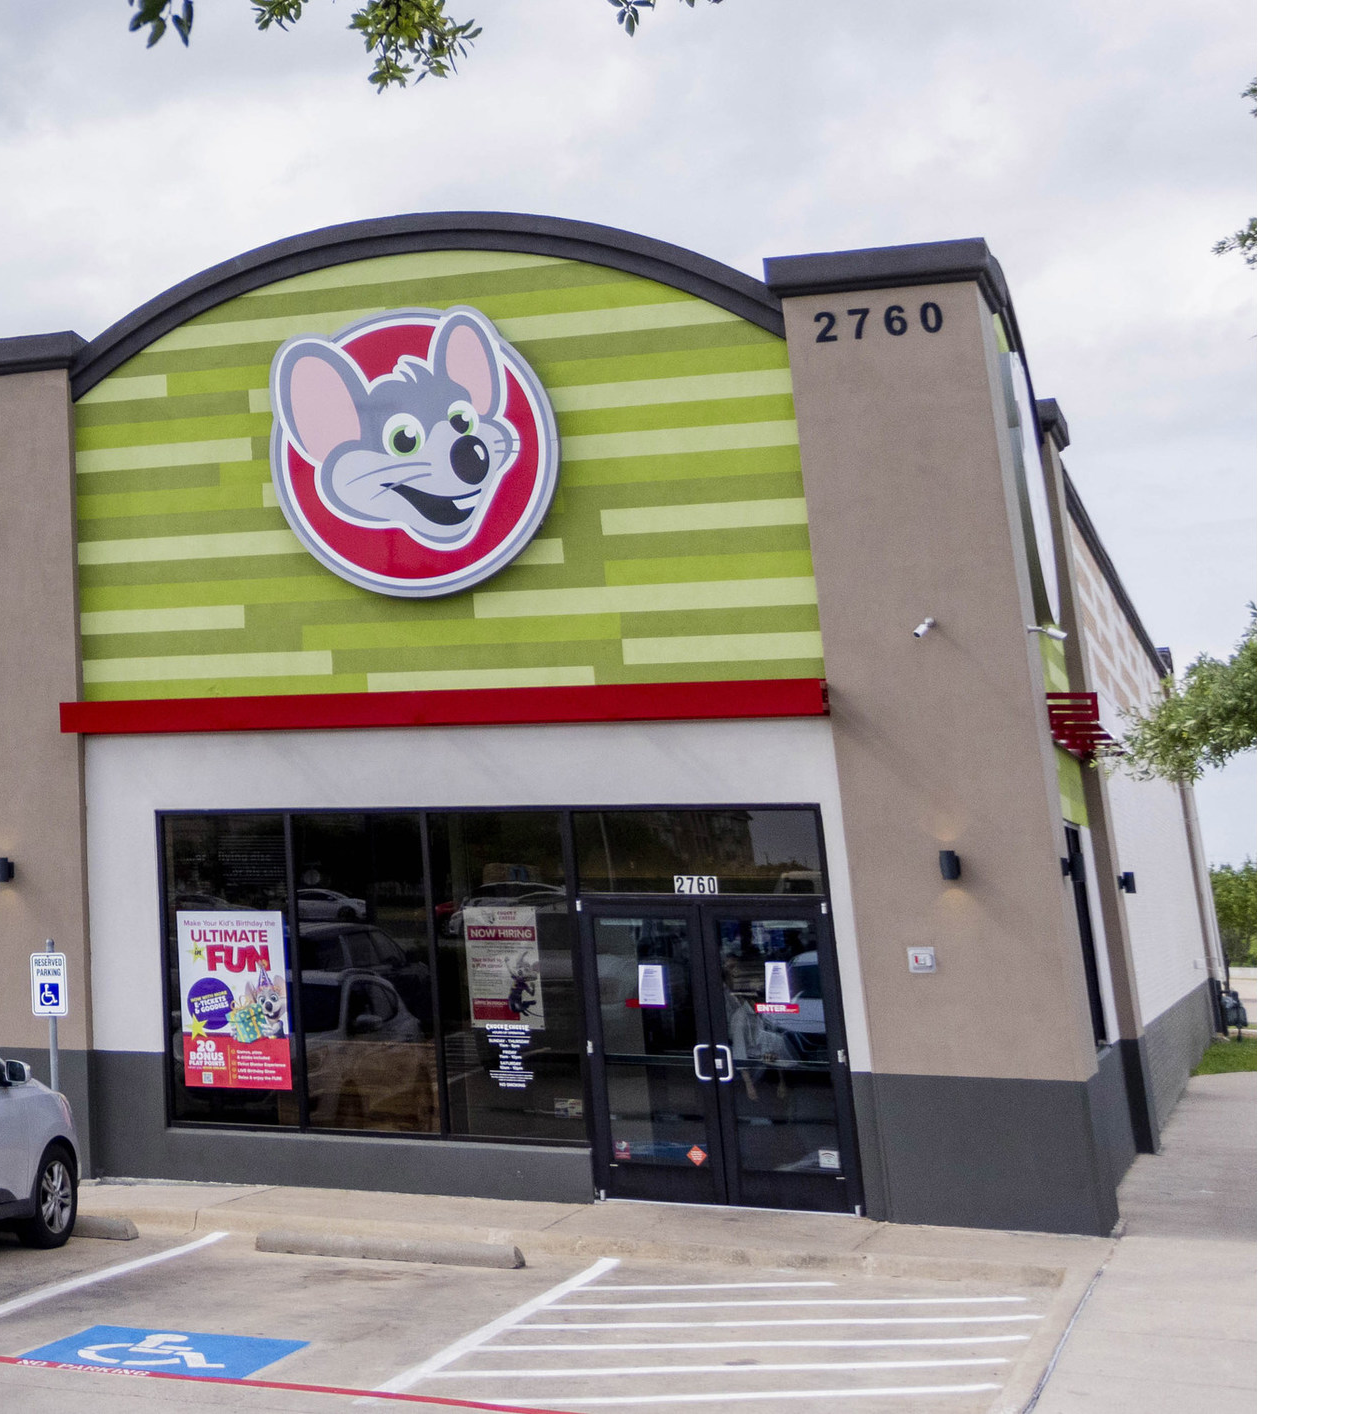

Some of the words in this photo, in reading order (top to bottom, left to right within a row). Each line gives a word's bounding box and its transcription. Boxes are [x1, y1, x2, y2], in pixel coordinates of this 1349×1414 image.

[814, 302, 943, 343] 2760
[676, 877, 716, 893] 2760
[236, 920, 262, 928] Birthday
[191, 930, 268, 943] ULTIMATE
[471, 929, 495, 938] NOW
[498, 930, 532, 938] HIRING
[34, 958, 62, 966] RESERVED
[206, 944, 271, 973] FUN
[37, 968, 61, 976] PARKING
[194, 996, 226, 1007] E-TICKETS
[201, 1001, 229, 1012] GOODIES
[757, 1004, 786, 1012] ENTER
[197, 1041, 215, 1052] 20
[190, 1052, 224, 1061] BONUS
[57, 1364, 150, 1376] PARKING
